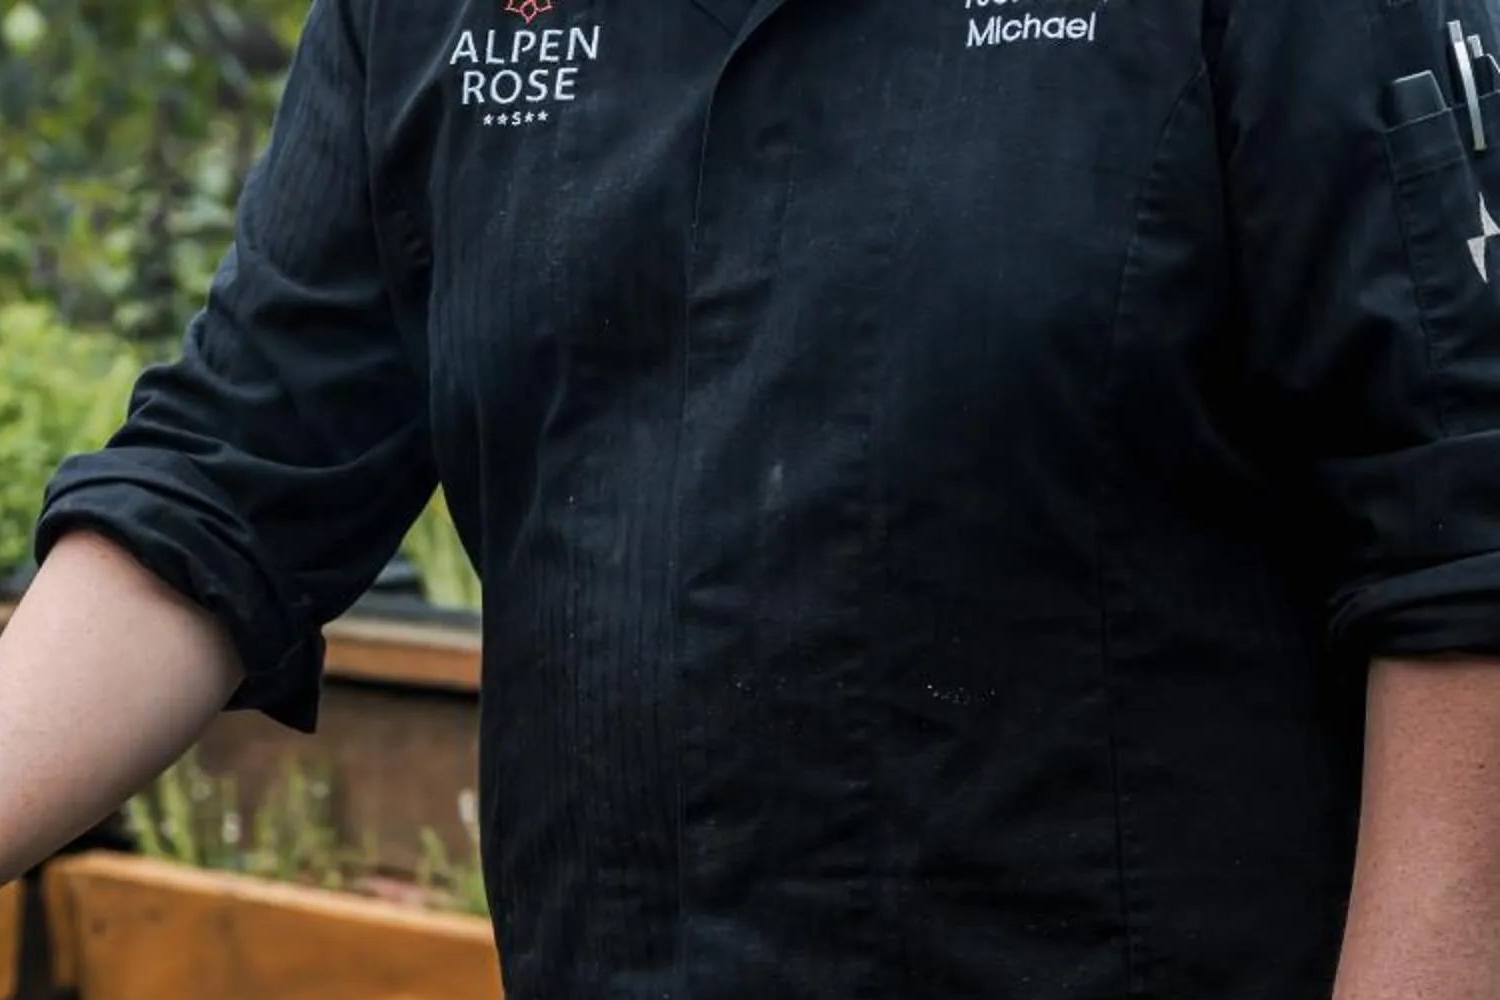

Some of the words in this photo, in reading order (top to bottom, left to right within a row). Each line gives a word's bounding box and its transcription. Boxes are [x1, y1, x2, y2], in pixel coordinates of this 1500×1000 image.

[450, 25, 600, 64] ALPEN
[966, 12, 1096, 47] Michael
[462, 67, 579, 104] ROSE
